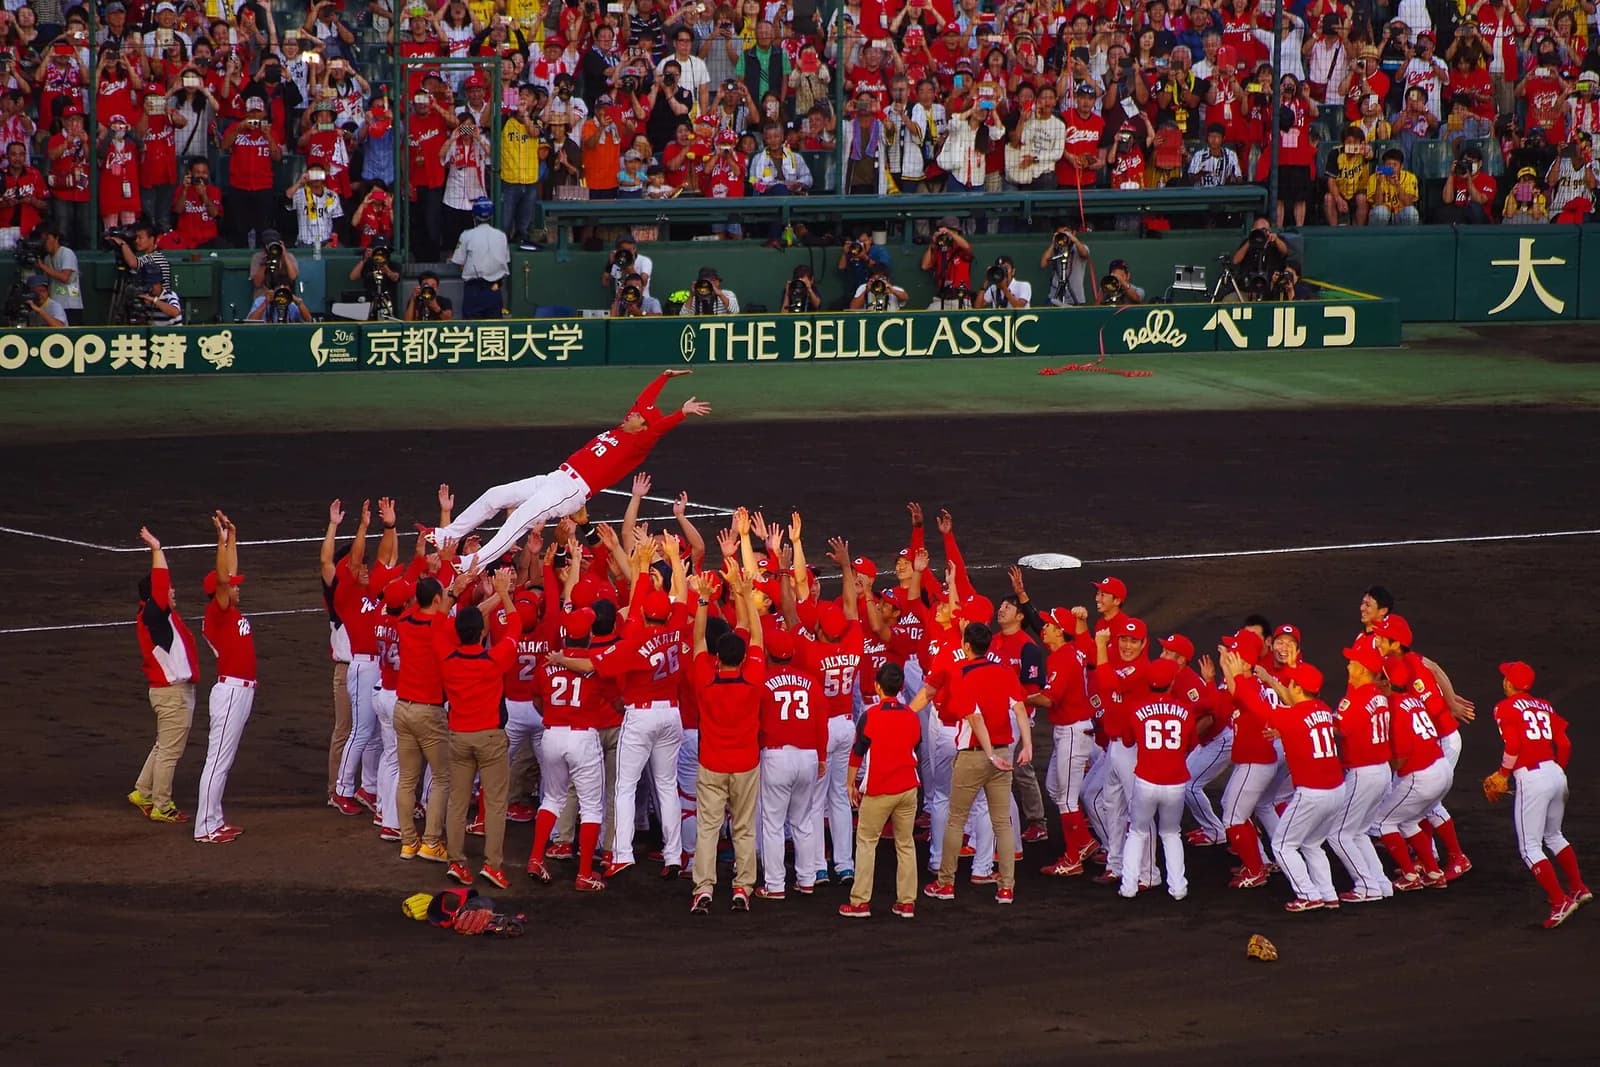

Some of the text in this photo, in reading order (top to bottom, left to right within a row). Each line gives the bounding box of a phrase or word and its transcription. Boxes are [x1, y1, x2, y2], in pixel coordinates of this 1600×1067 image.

[1488, 237, 1566, 315] 大
[699, 314, 1041, 361] THE BELLCLASSIC
[1203, 305, 1356, 348] ベルコ
[366, 323, 583, 366] 京都学園大学
[638, 630, 680, 658] NAKATA
[518, 655, 536, 681] 2
[650, 645, 680, 681] 26
[551, 676, 582, 707] 21
[824, 667, 854, 697] 58
[774, 691, 810, 721] 73
[1135, 703, 1189, 721] NISHIKAWA
[1145, 720, 1182, 750] 63
[1412, 710, 1439, 741] 49
[1522, 714, 1553, 741] 33
